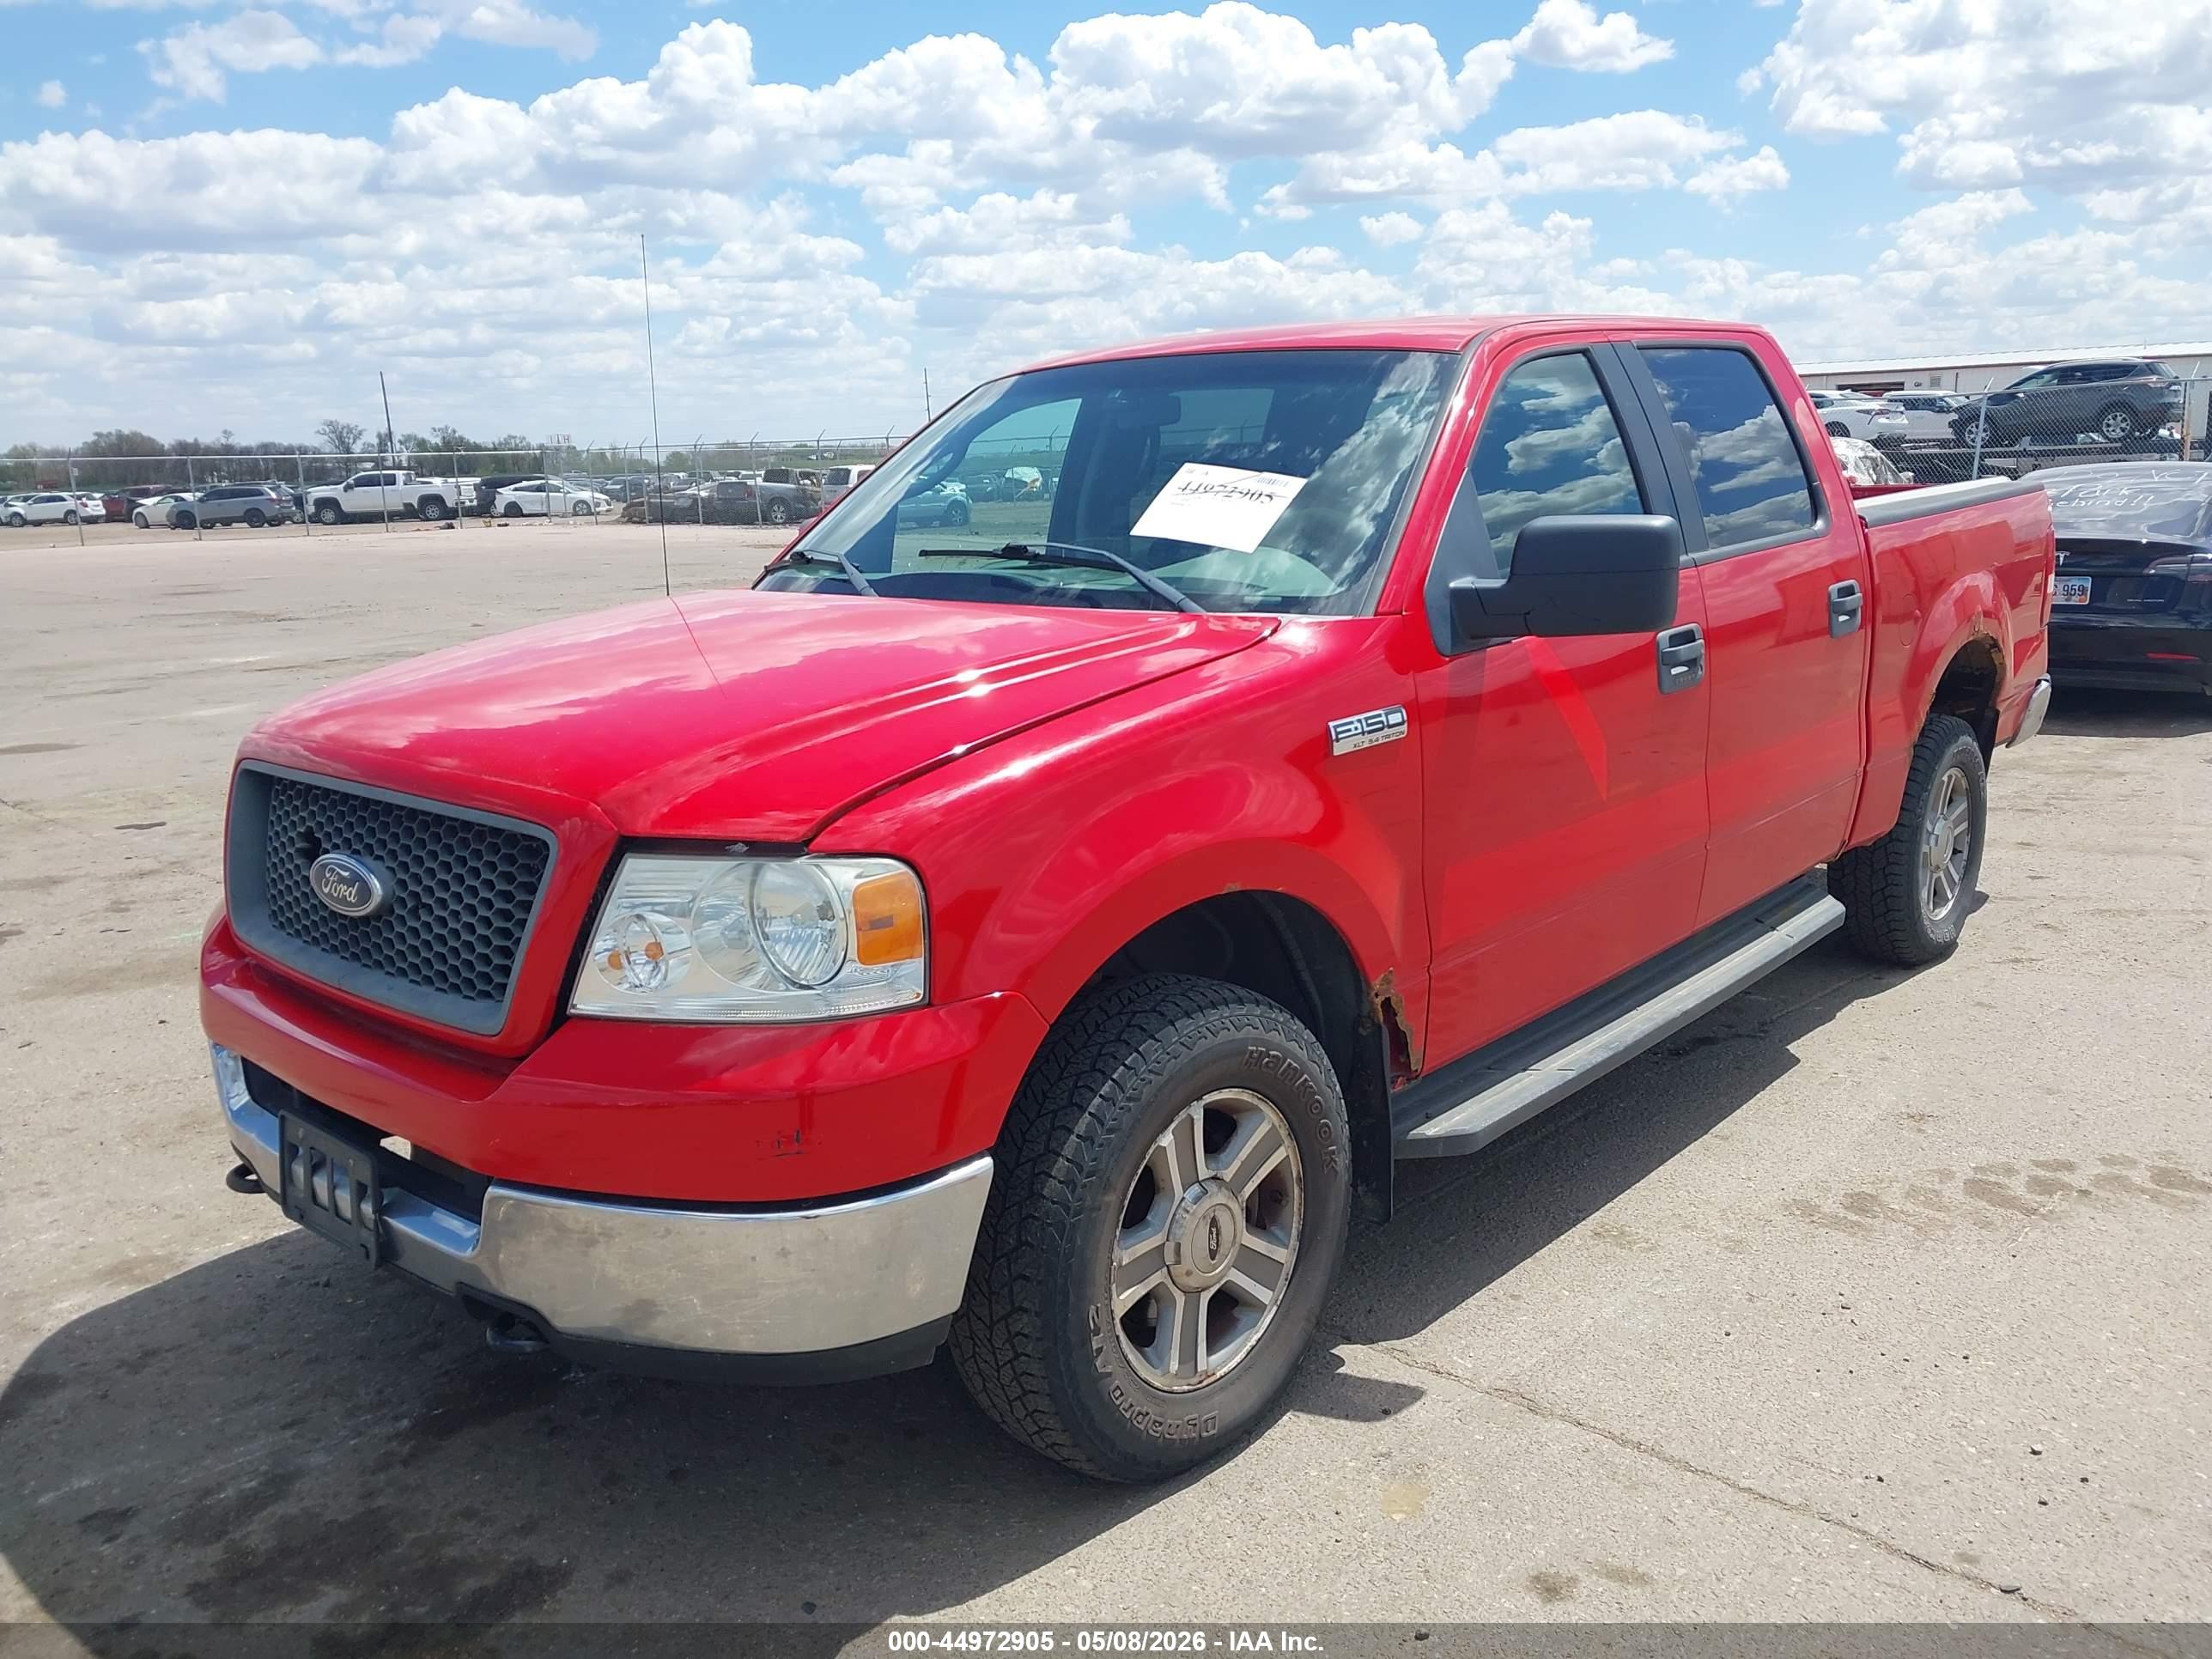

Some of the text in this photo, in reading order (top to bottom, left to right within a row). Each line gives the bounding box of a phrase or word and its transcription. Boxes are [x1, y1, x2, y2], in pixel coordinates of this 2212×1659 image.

[2063, 584, 2085, 597] 959
[1352, 740, 1365, 749] XLT
[1380, 730, 1405, 740] TRITON
[322, 865, 359, 903] Ford
[1108, 1381, 1219, 1440] Dynapro
